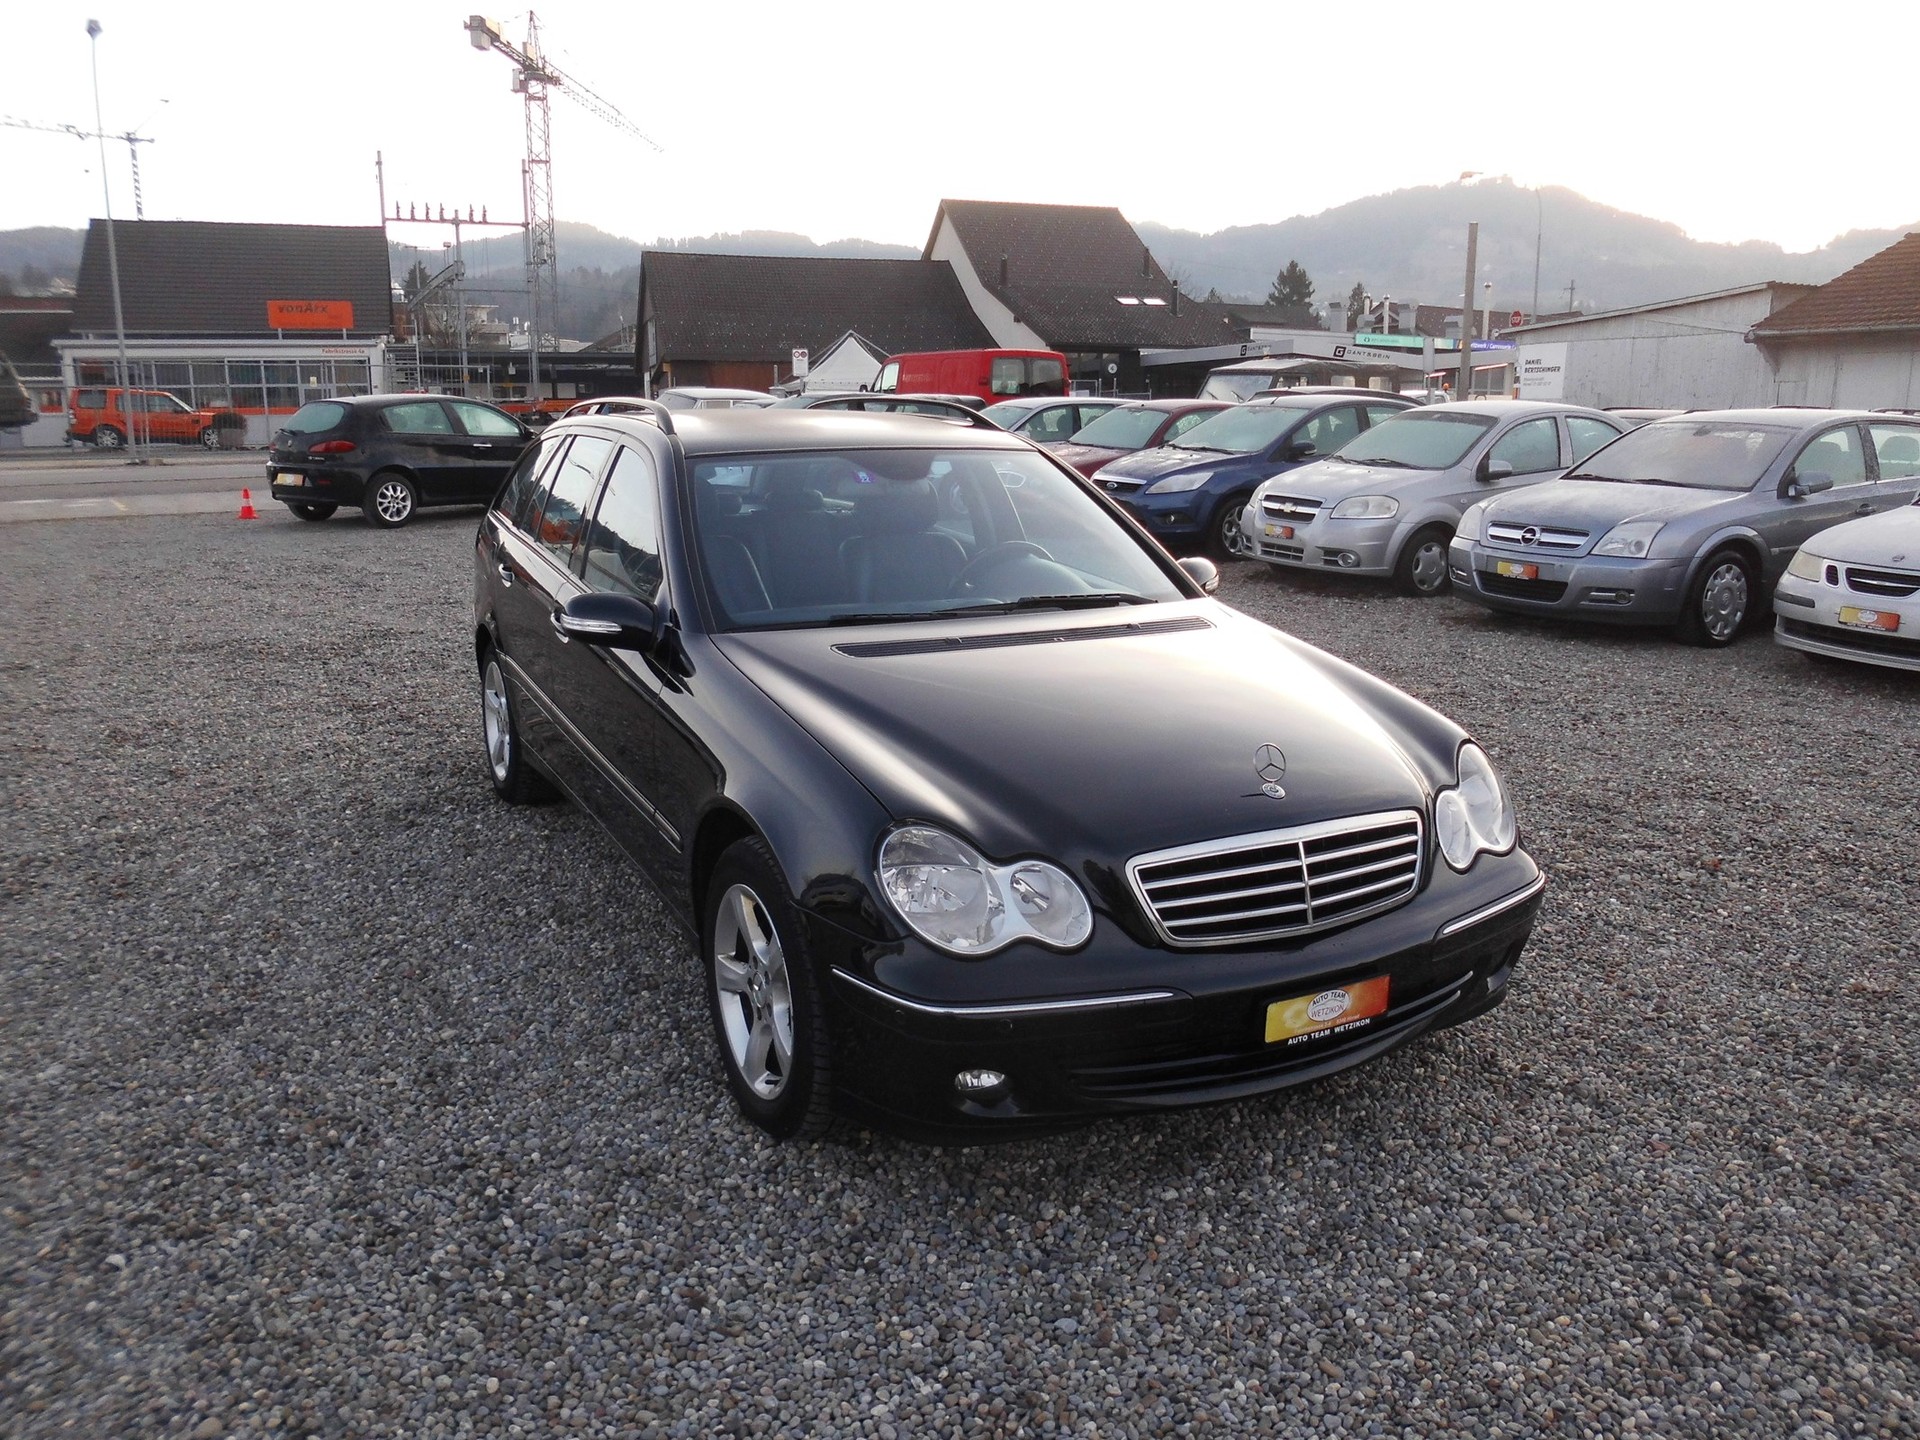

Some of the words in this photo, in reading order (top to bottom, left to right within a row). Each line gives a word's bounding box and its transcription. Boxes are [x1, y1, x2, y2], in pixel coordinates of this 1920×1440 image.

[1312, 993, 1329, 1006] AUTO
[1330, 991, 1346, 999] TEAM
[1311, 1004, 1345, 1018] WETZIKON
[1287, 1035, 1308, 1046] AUTO
[1311, 1029, 1331, 1039] TEAM
[1334, 1018, 1371, 1033] WETZIKON
